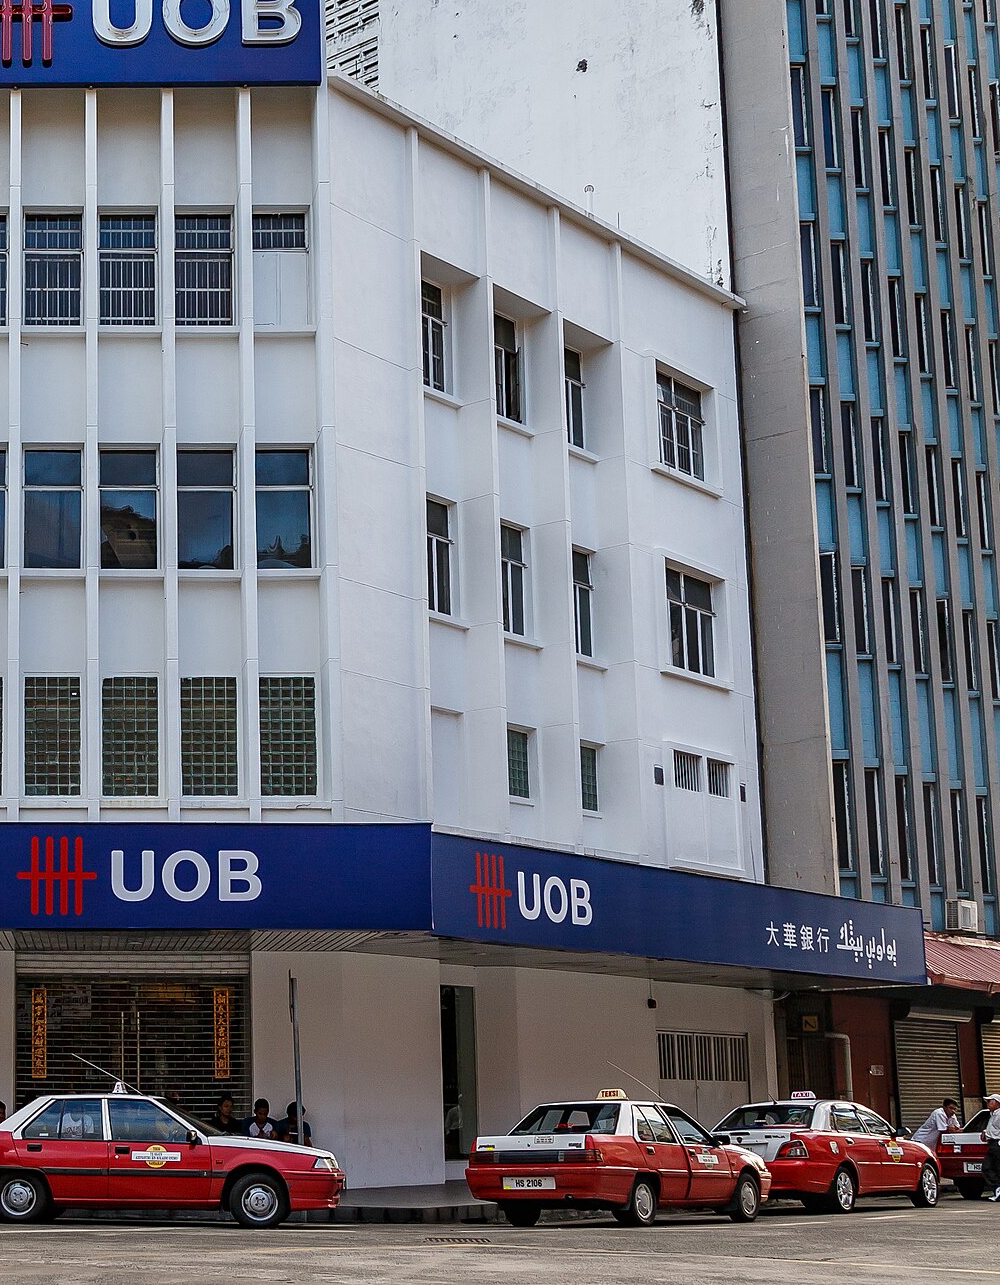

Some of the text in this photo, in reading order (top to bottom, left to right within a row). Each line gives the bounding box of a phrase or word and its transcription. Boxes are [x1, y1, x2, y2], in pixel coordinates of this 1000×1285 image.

[110, 849, 263, 902] UOB
[517, 871, 593, 926] UOB
[765, 921, 830, 953] 大華銀行
[601, 1090, 619, 1098] TEKSI
[515, 1179, 543, 1188] HS 2106
